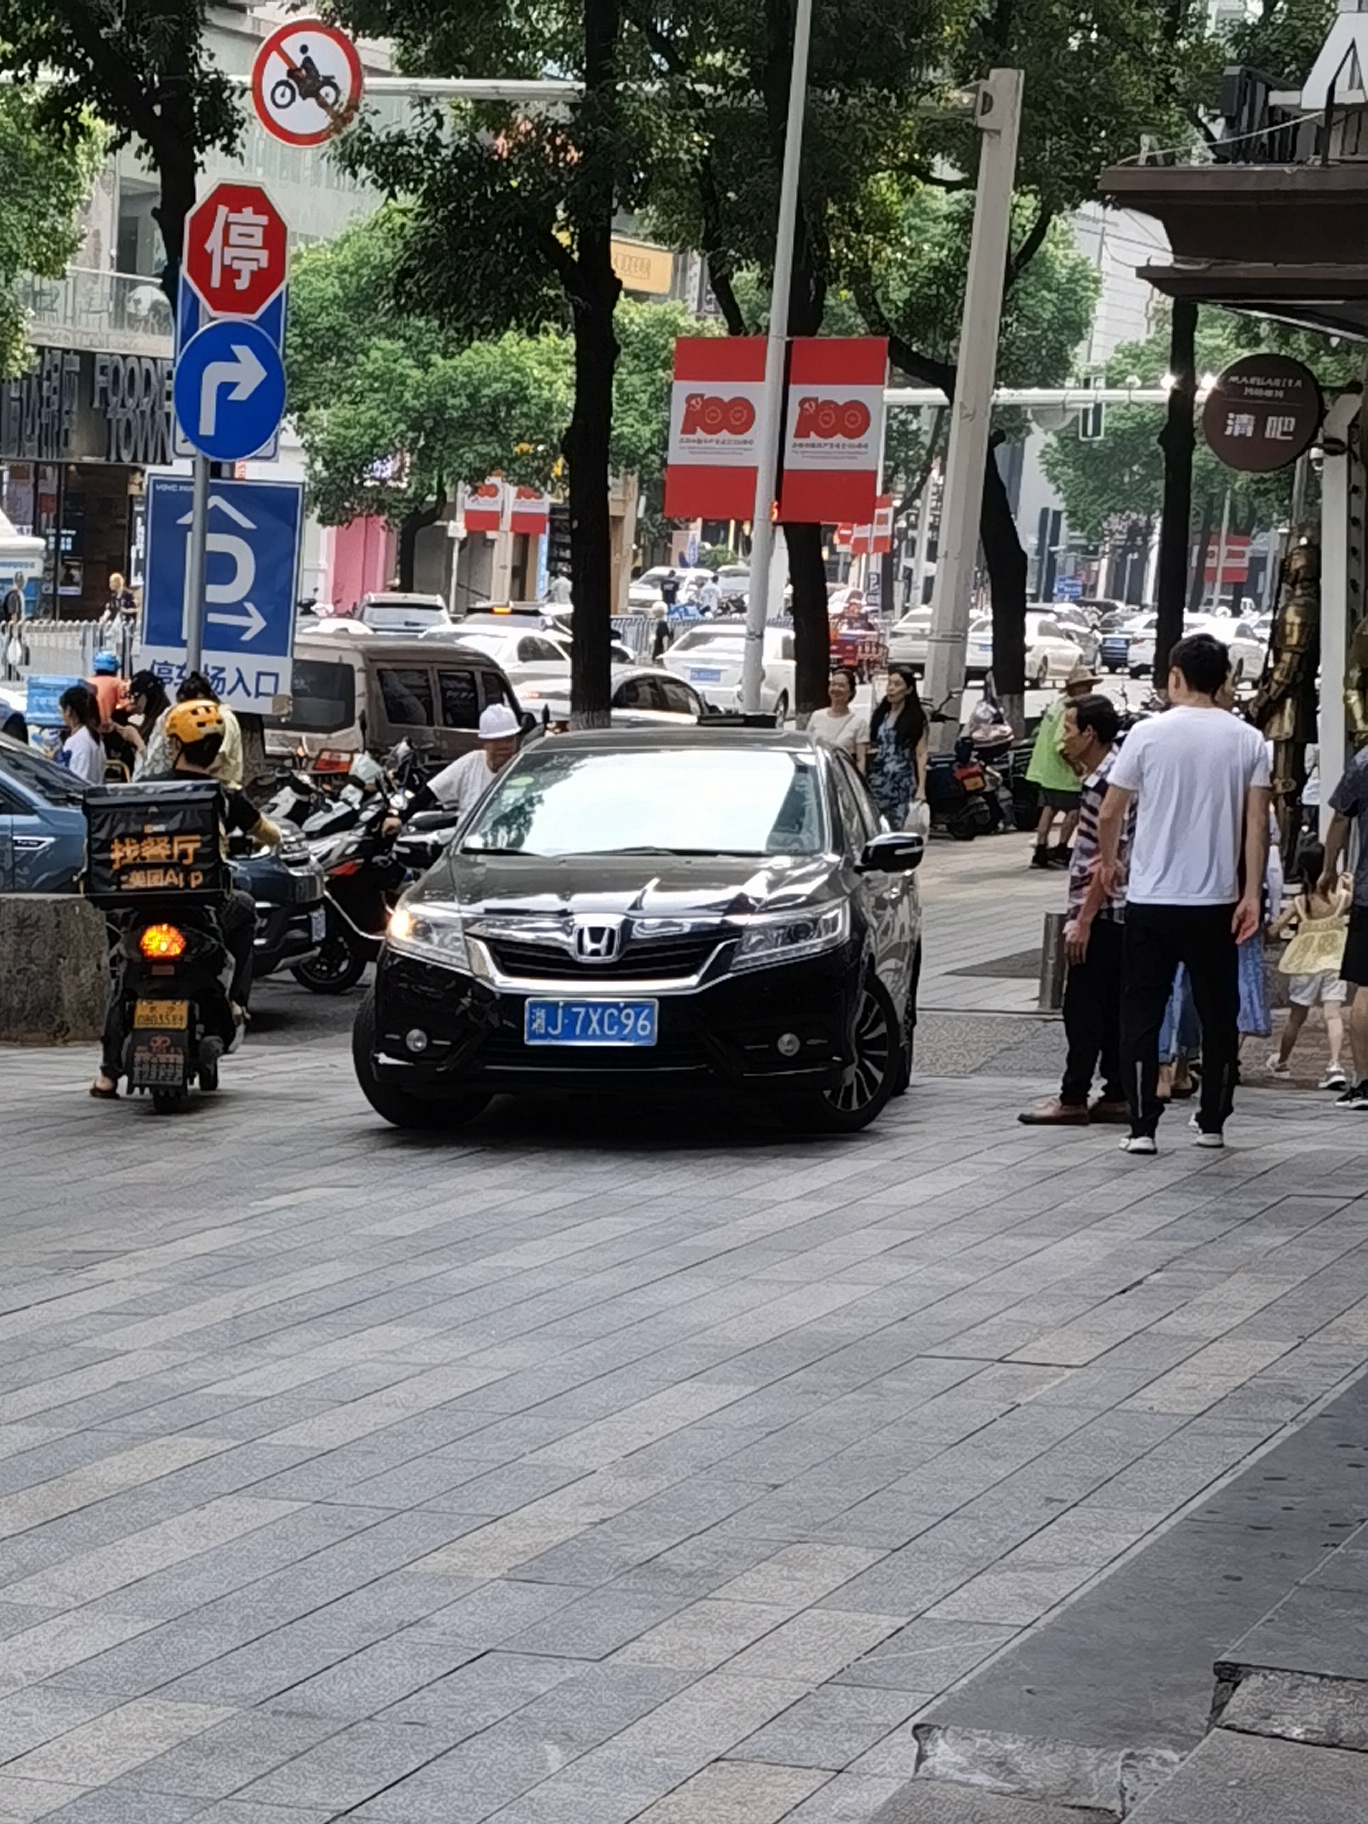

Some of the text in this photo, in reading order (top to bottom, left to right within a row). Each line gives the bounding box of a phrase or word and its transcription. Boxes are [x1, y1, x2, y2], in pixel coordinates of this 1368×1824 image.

[204, 204, 269, 290] 停
[1224, 412, 1296, 440] 清吧
[110, 834, 202, 870] 找餐厅
